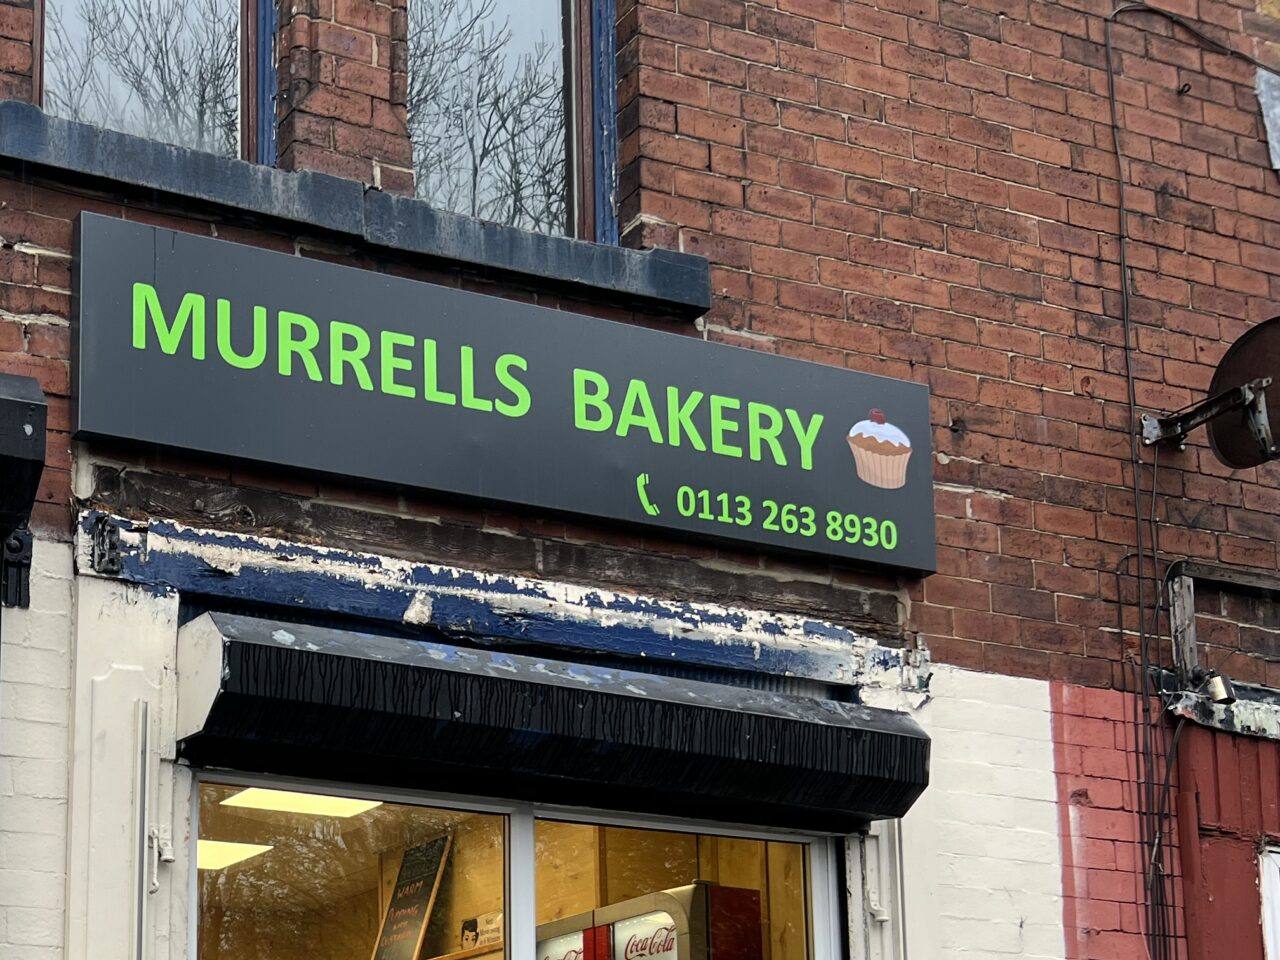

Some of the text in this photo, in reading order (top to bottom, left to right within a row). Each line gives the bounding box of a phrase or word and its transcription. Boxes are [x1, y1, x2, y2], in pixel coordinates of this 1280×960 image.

[131, 282, 825, 470] MURRELLS BAKERY
[676, 485, 899, 550] 0113 263 8930
